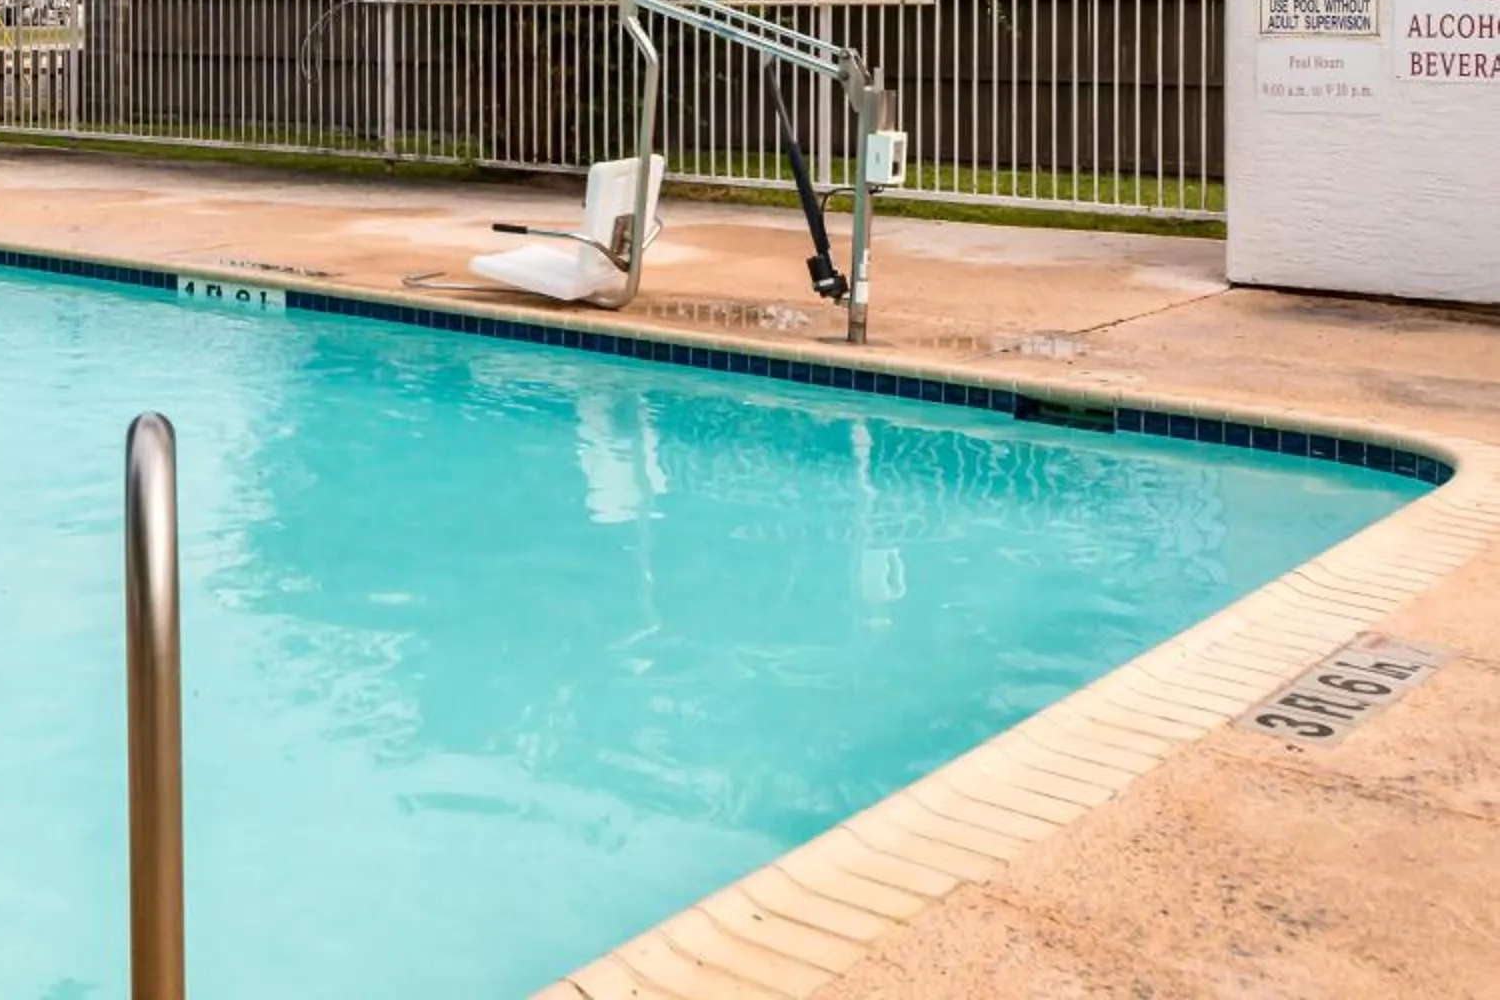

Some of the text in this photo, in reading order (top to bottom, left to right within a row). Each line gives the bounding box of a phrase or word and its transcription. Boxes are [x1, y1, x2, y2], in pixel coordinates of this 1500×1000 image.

[1269, 0, 1370, 13] USE POOL WITHOUT
[1268, 15, 1371, 30] ADULT SUPERVISION
[1407, 13, 1500, 38] ALCOH
[1256, 713, 1335, 738] 3
[1317, 674, 1392, 696] 6
